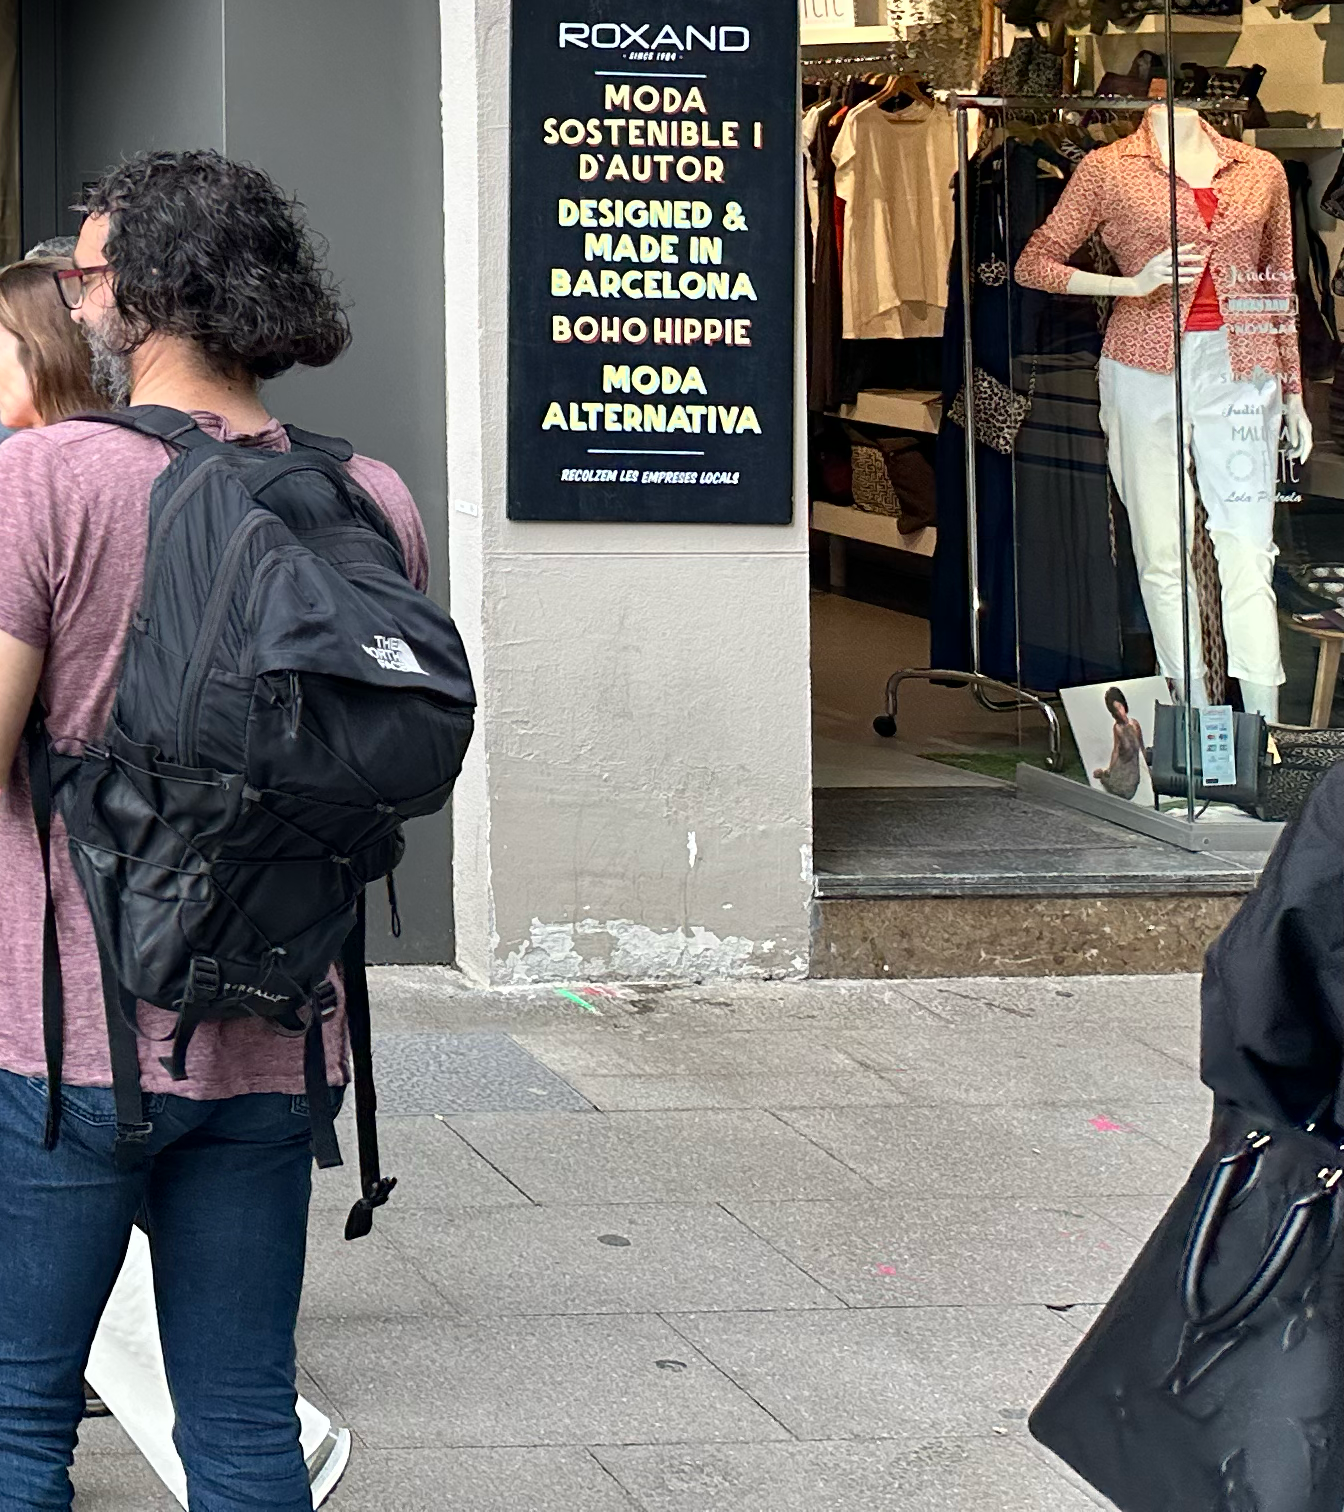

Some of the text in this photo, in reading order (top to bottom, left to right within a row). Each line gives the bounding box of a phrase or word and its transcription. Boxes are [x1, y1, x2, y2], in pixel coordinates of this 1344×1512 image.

[559, 23, 751, 52] ROXAND
[604, 84, 707, 114] MODA
[543, 117, 763, 148] SOSTENIBLE I
[579, 153, 725, 183] D'AUTOR
[558, 199, 749, 232] DESIGNED &
[584, 233, 723, 265] MADE IN
[551, 268, 758, 301] BARCELONA
[552, 315, 752, 346] BOHO HIPPIE
[603, 365, 708, 396] MODA
[542, 402, 762, 435] ALTERNATIVA
[561, 468, 740, 485] RECOLZEM LES EMPRESES LOCALS
[374, 635, 399, 650] THE
